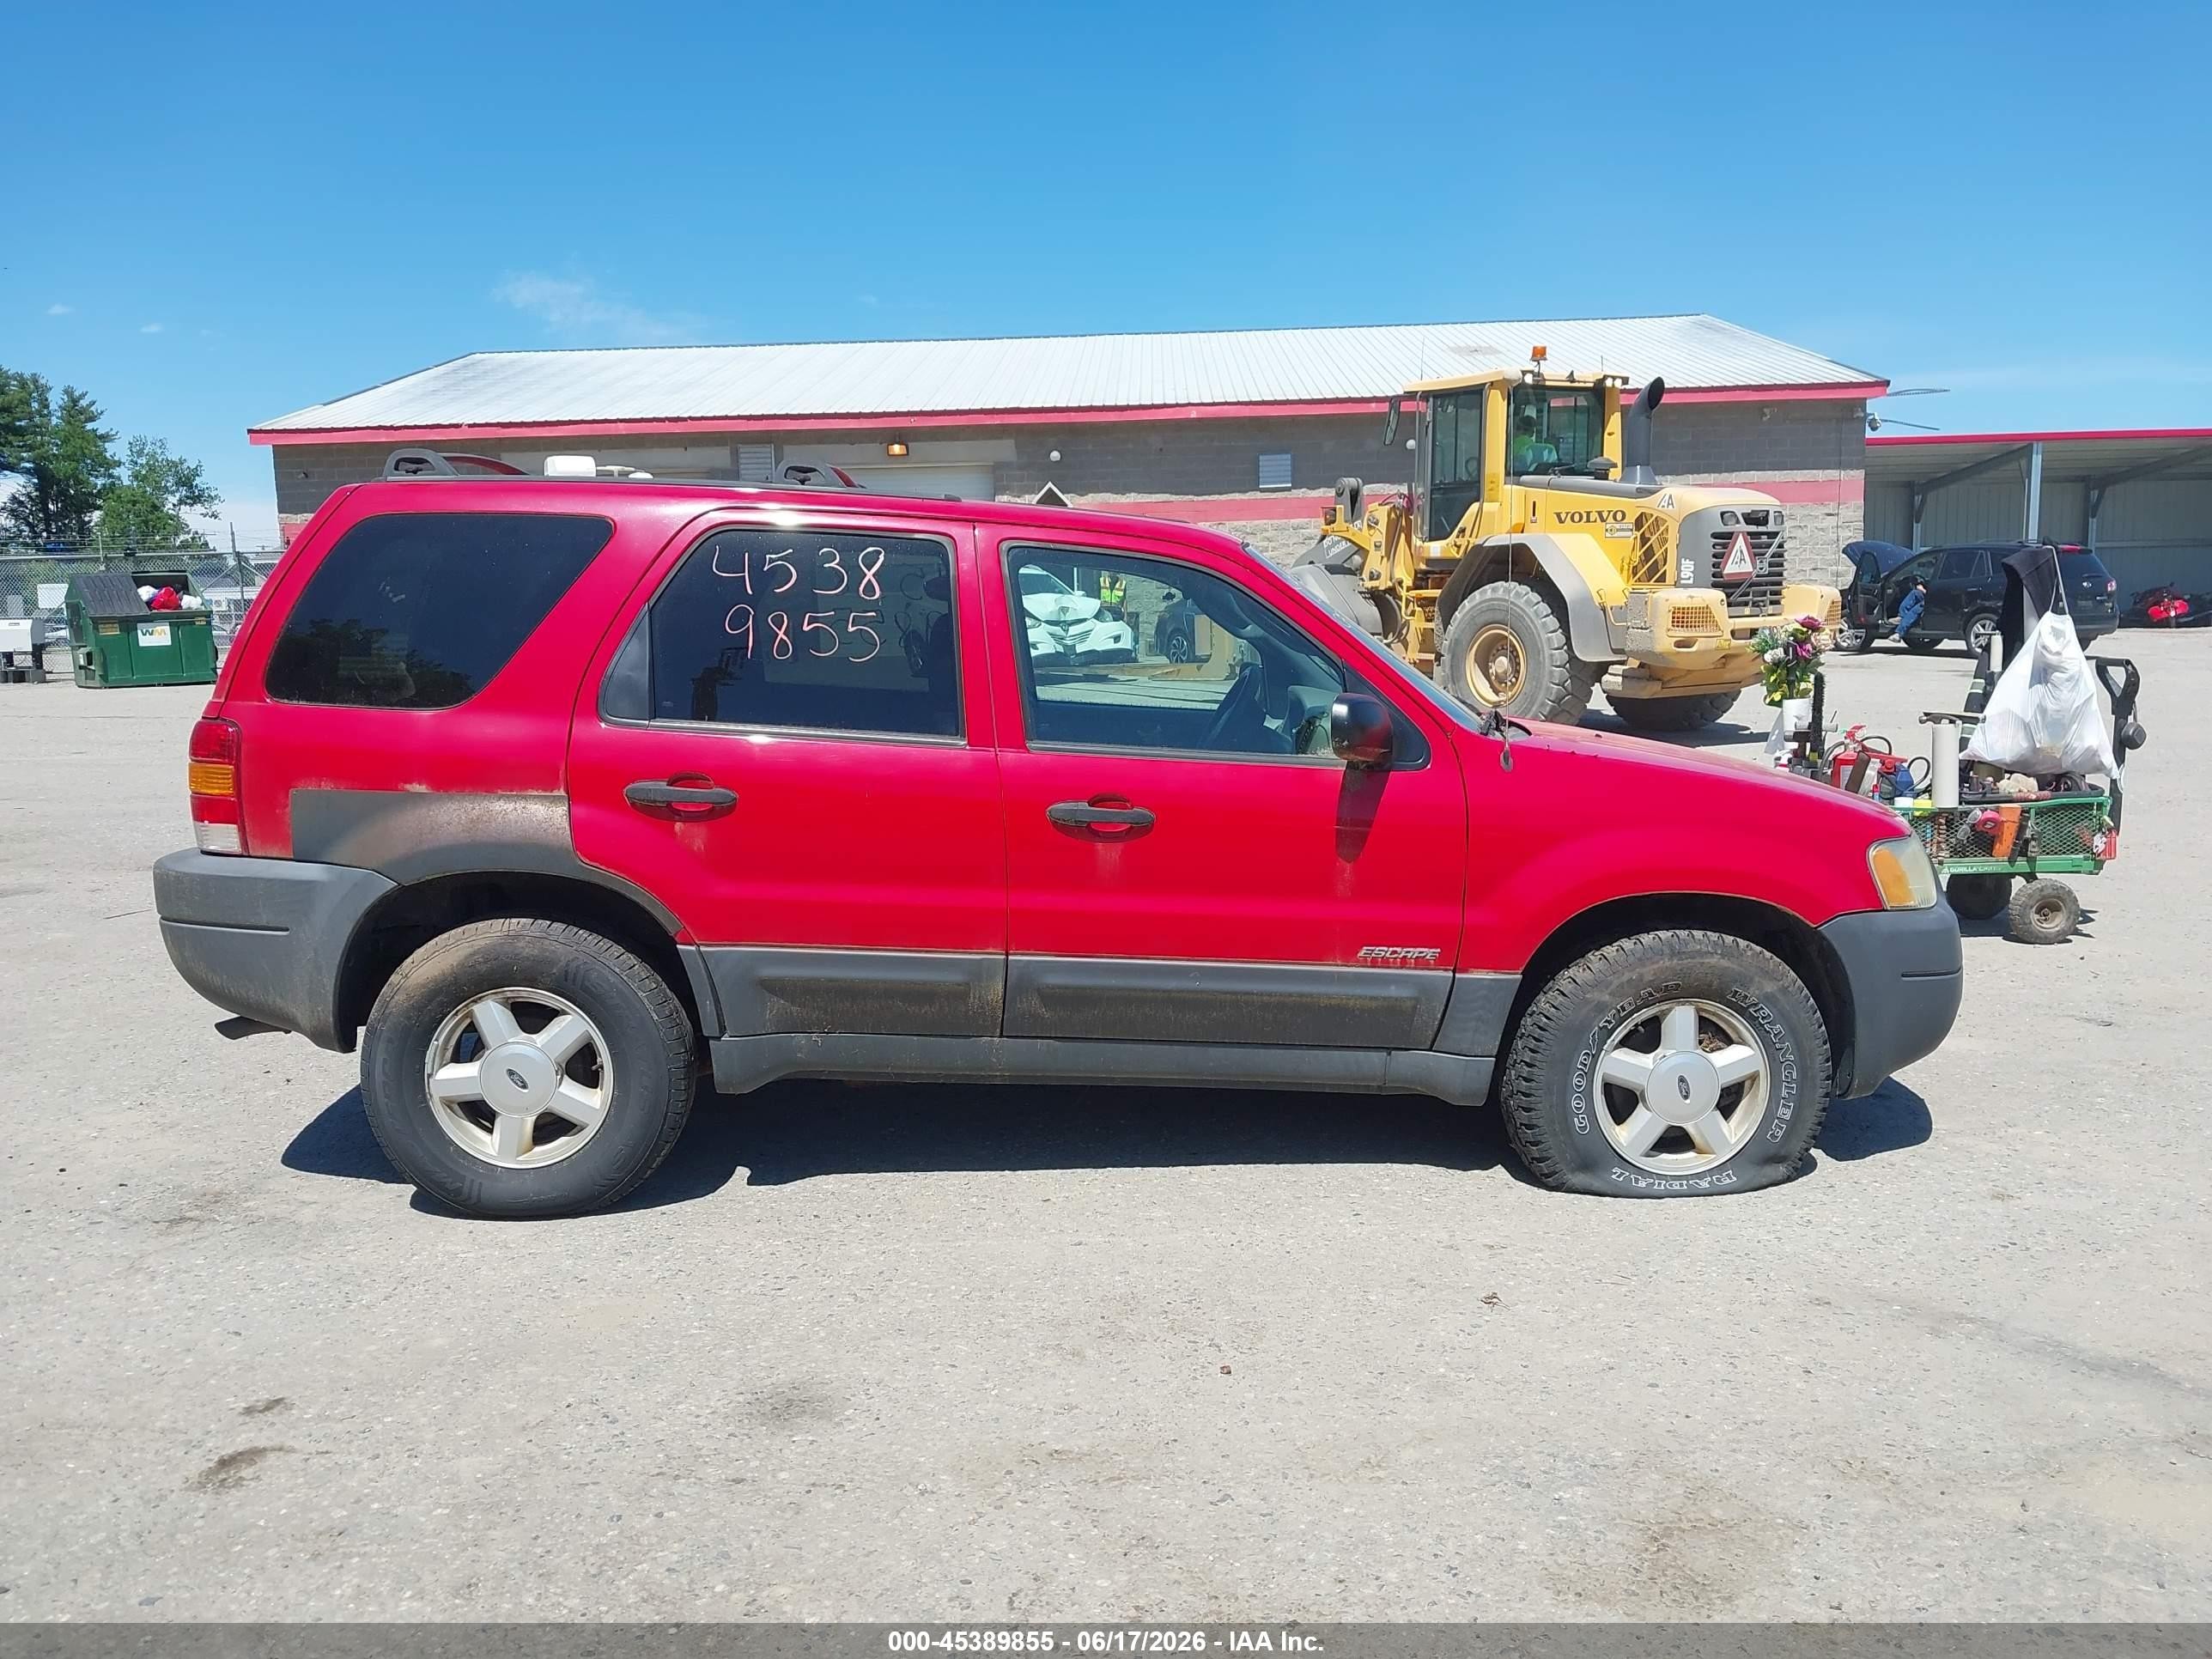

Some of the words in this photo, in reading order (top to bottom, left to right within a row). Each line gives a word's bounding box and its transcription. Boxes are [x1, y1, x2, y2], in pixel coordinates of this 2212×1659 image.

[1553, 509, 1626, 525] VOLVO
[712, 545, 885, 600] 4538
[1680, 558, 1695, 585] L90F
[140, 629, 167, 637] WM
[725, 604, 880, 663] 9855
[1358, 946, 1441, 960] ESCAPE
[1727, 988, 1797, 1144] WRANGLER
[1611, 1167, 1737, 1190] RADIAL
